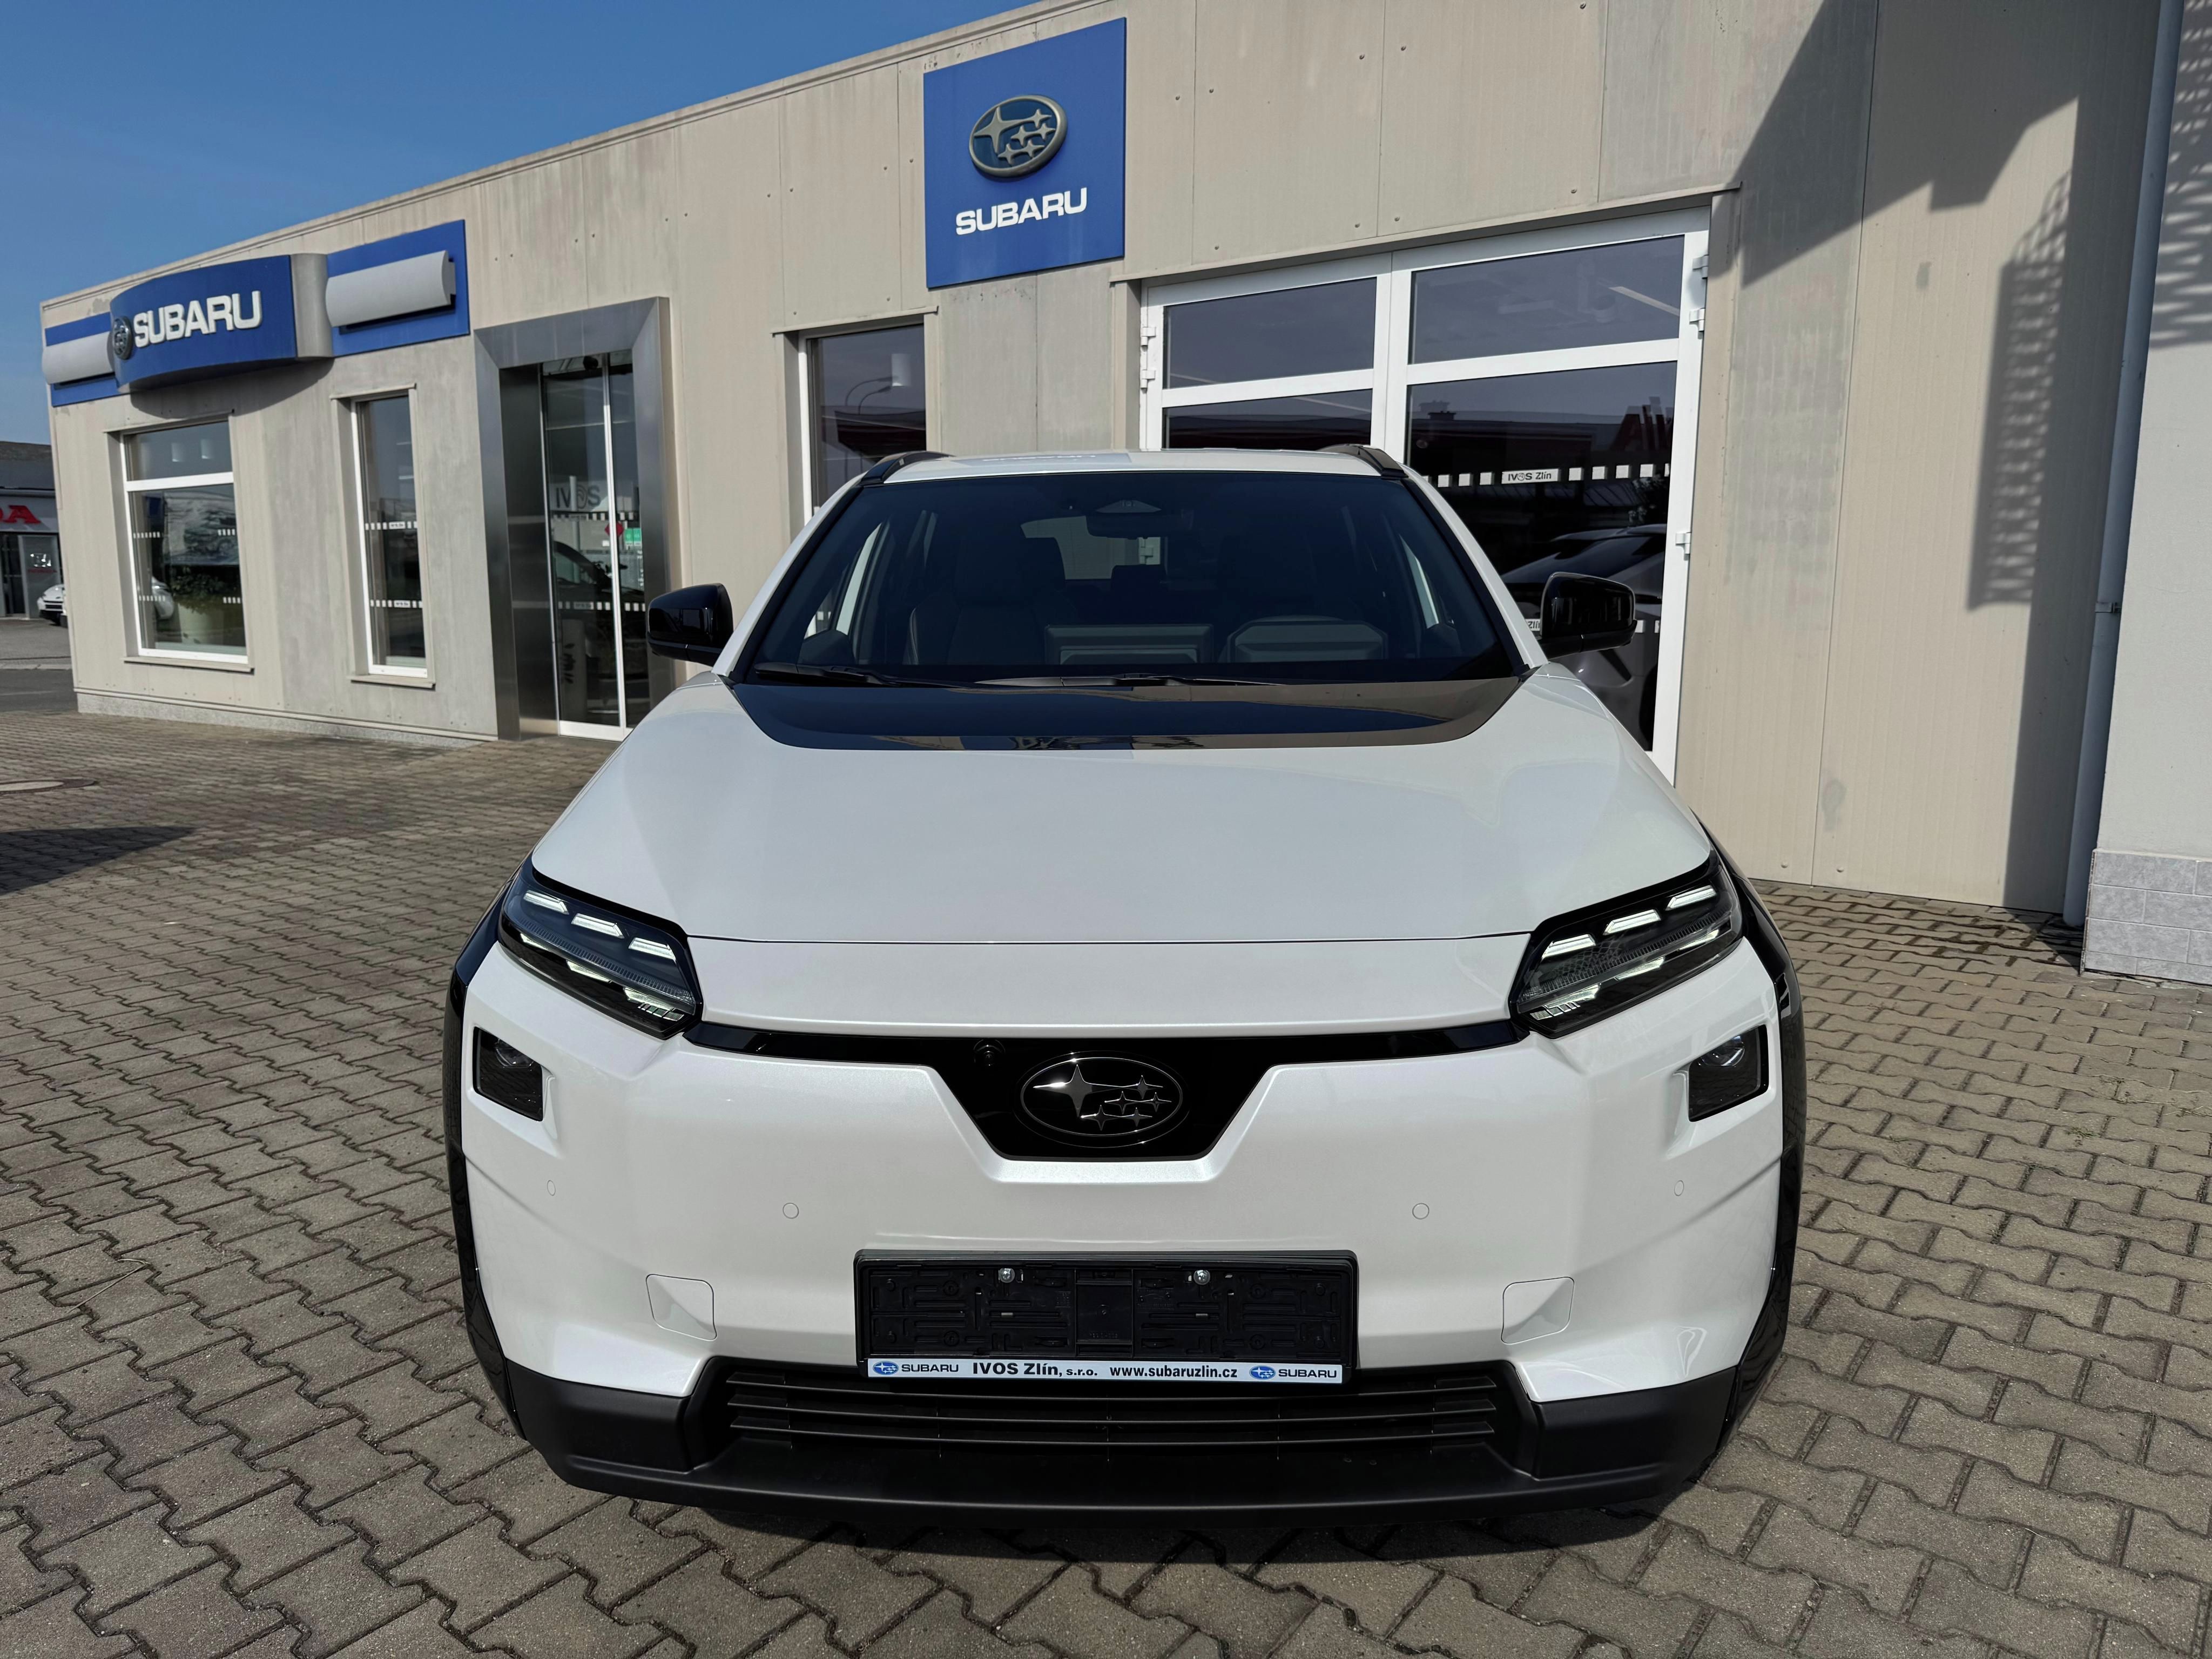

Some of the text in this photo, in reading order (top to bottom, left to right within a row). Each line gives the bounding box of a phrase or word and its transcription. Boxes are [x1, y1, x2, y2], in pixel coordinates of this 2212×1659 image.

[955, 187, 1088, 235] SUBARU
[134, 291, 261, 348] SUBARU
[1535, 471, 1552, 480] Zlín
[1528, 621, 1540, 629] Zlí
[901, 1363, 1337, 1378] SUBARU IVOS Zlín, s.r.o. www.subaruzlin.cz SUBARU
